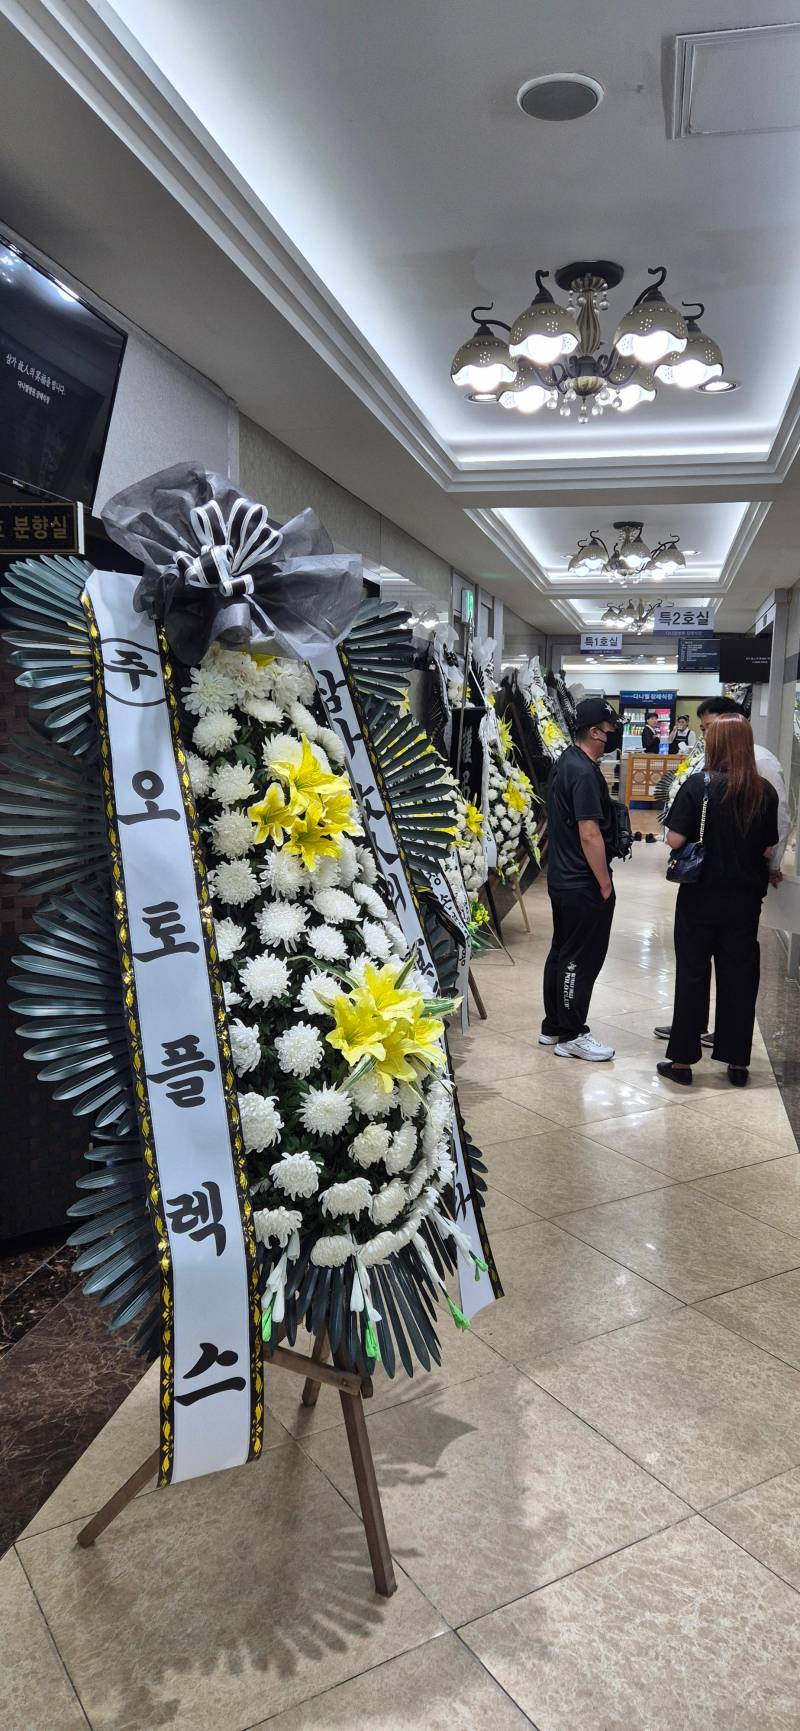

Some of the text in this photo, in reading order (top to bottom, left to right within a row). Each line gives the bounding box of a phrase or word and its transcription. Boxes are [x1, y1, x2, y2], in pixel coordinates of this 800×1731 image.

[14, 515, 67, 540] 분향실
[658, 610, 709, 626] 특2호실
[584, 636, 618, 647] 특1호실
